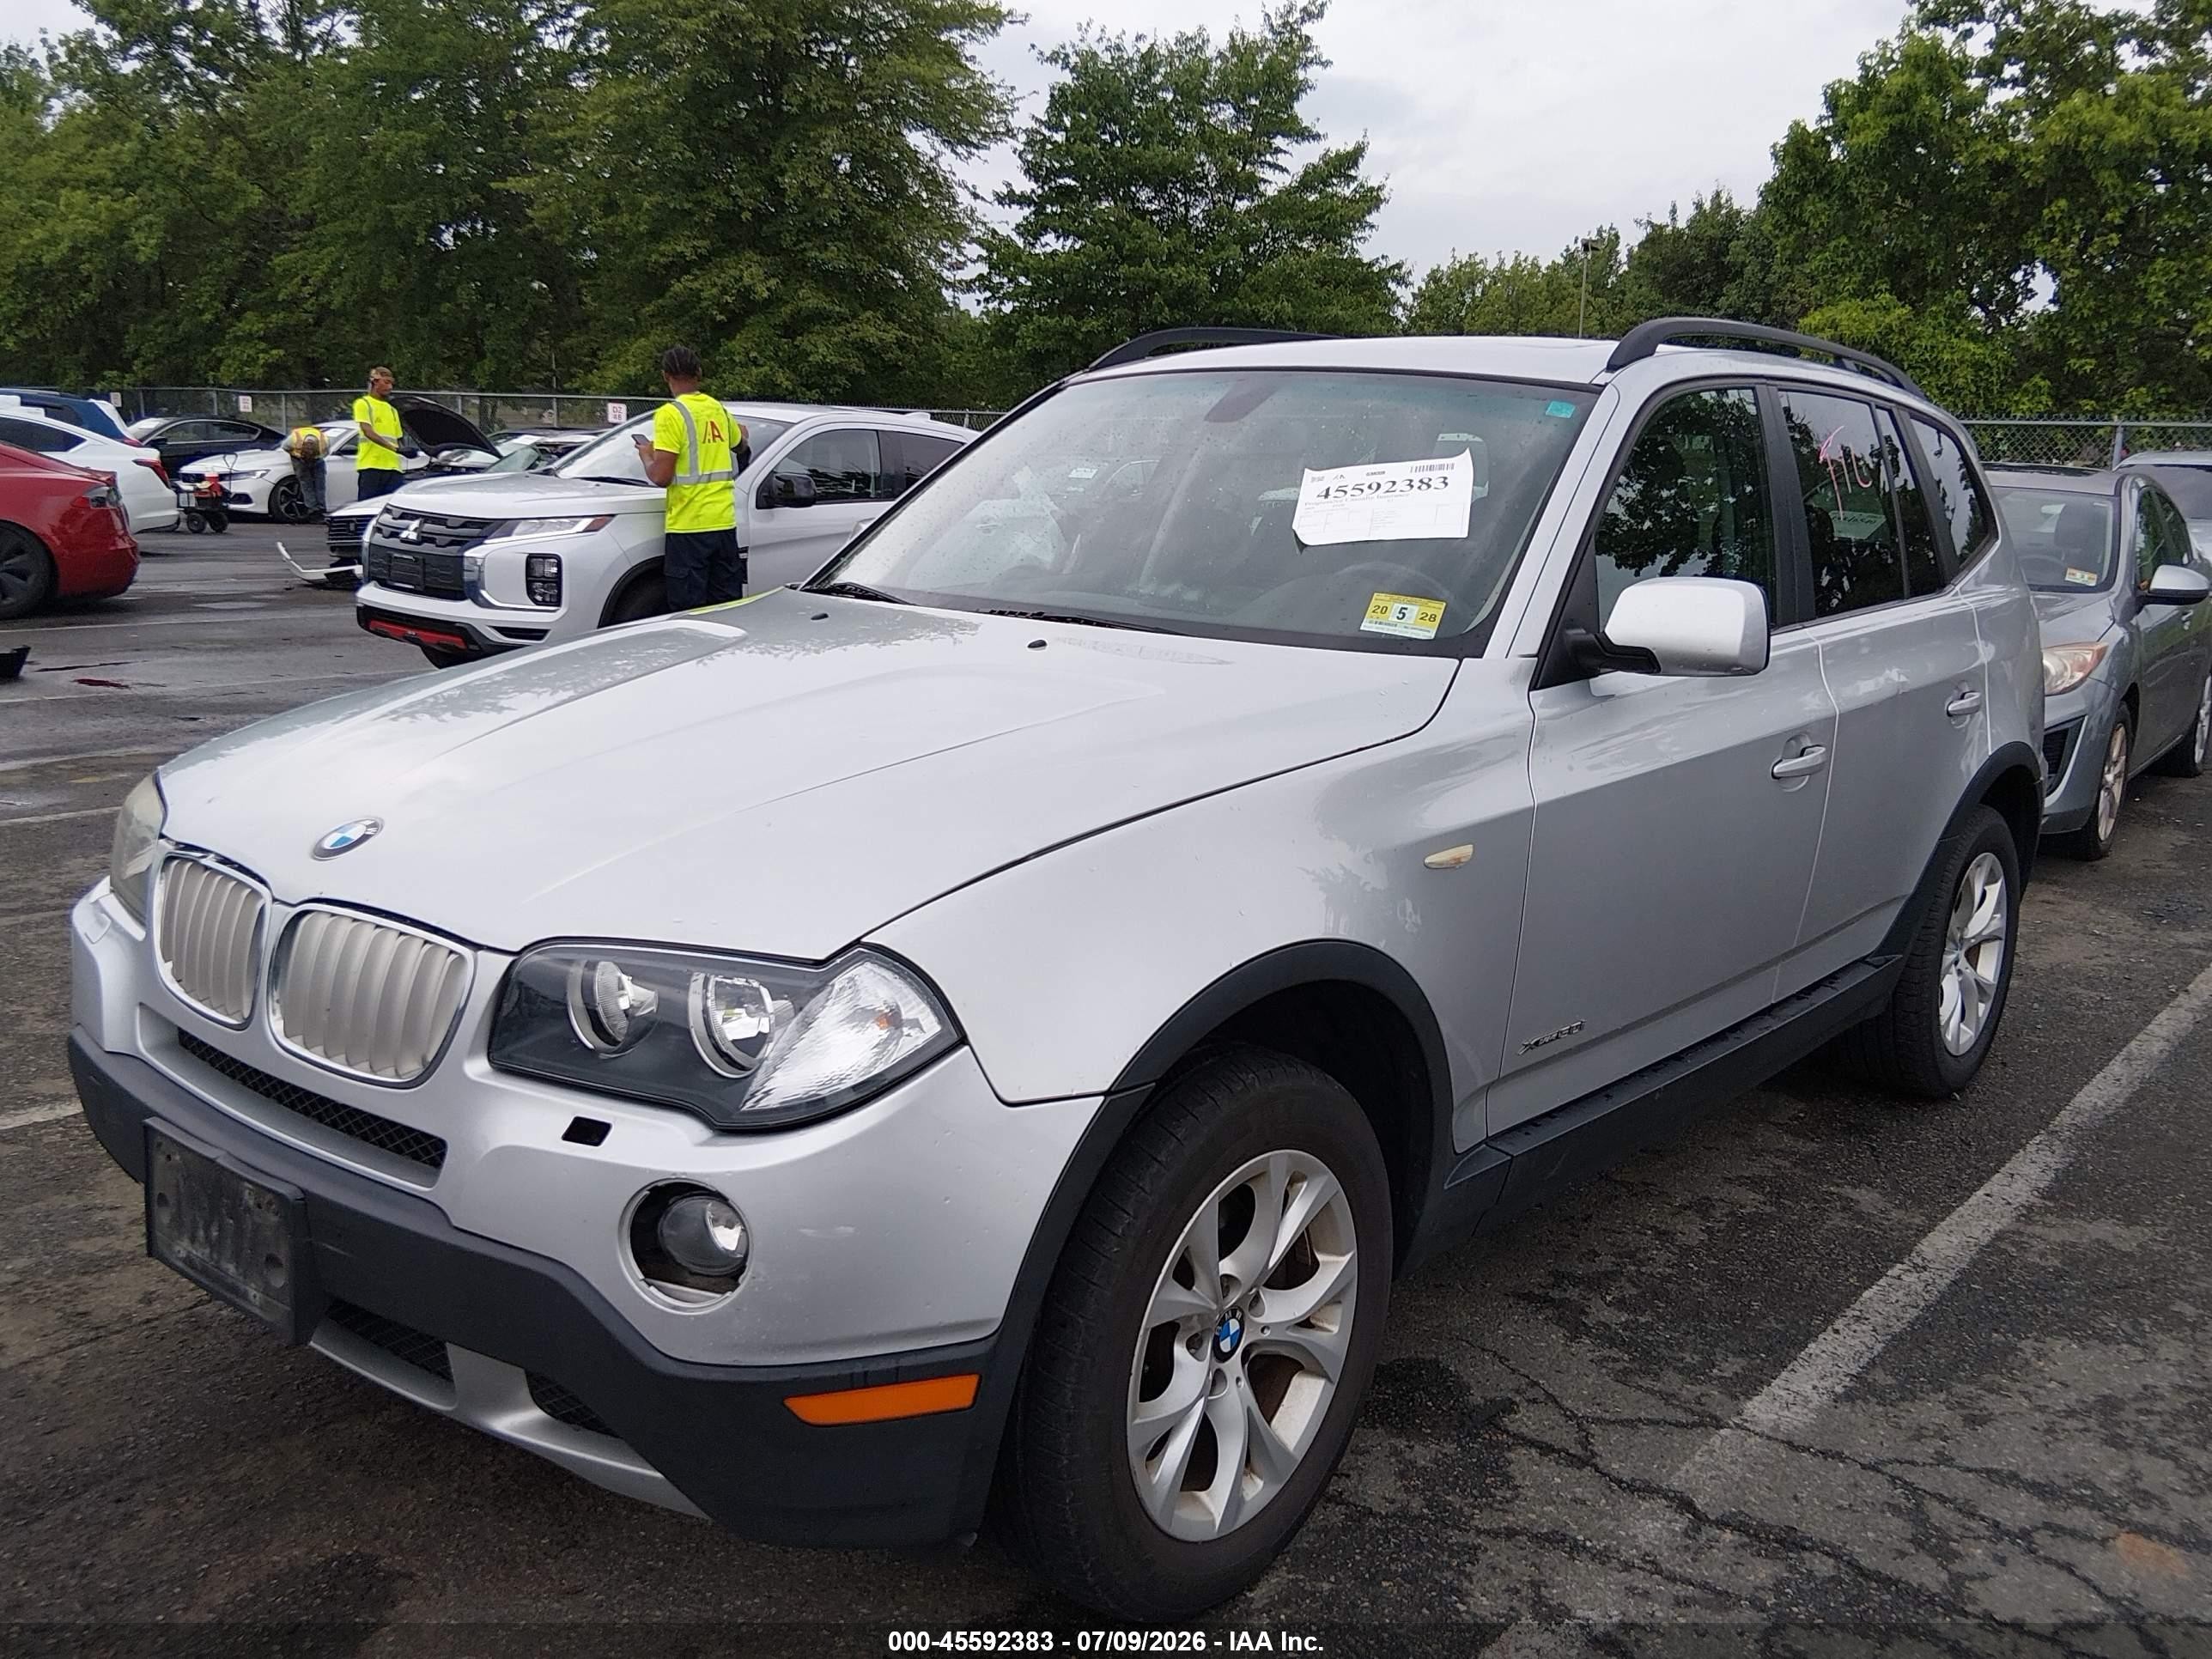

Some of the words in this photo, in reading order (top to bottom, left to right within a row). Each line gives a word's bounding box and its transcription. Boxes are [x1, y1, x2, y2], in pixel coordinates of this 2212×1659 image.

[1316, 476, 1449, 500] 45592383
[1371, 605, 1389, 615] 20
[1396, 606, 1408, 620] 5
[1419, 611, 1437, 623] 28
